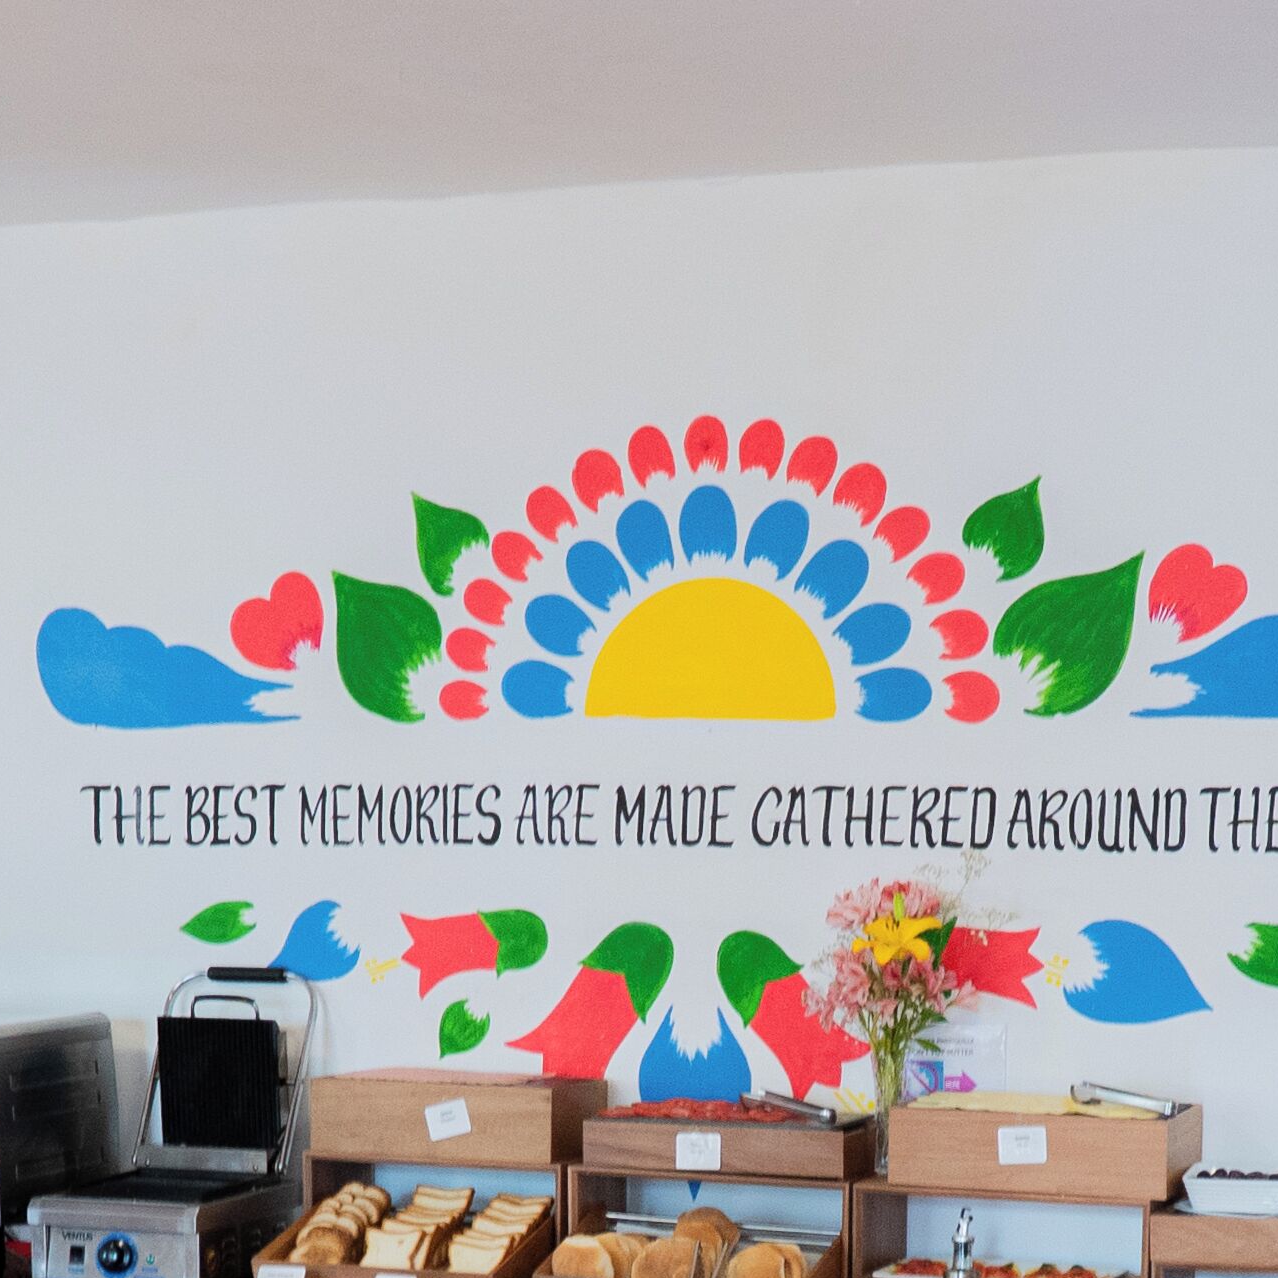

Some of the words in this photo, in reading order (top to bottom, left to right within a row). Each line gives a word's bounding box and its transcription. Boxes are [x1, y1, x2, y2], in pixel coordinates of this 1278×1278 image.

[80, 785, 170, 845] THE
[184, 784, 285, 845] BEST
[298, 783, 501, 845] MEMORIES
[516, 784, 599, 846] ARE
[614, 784, 735, 848] MADE
[1006, 786, 1186, 853] AROUND
